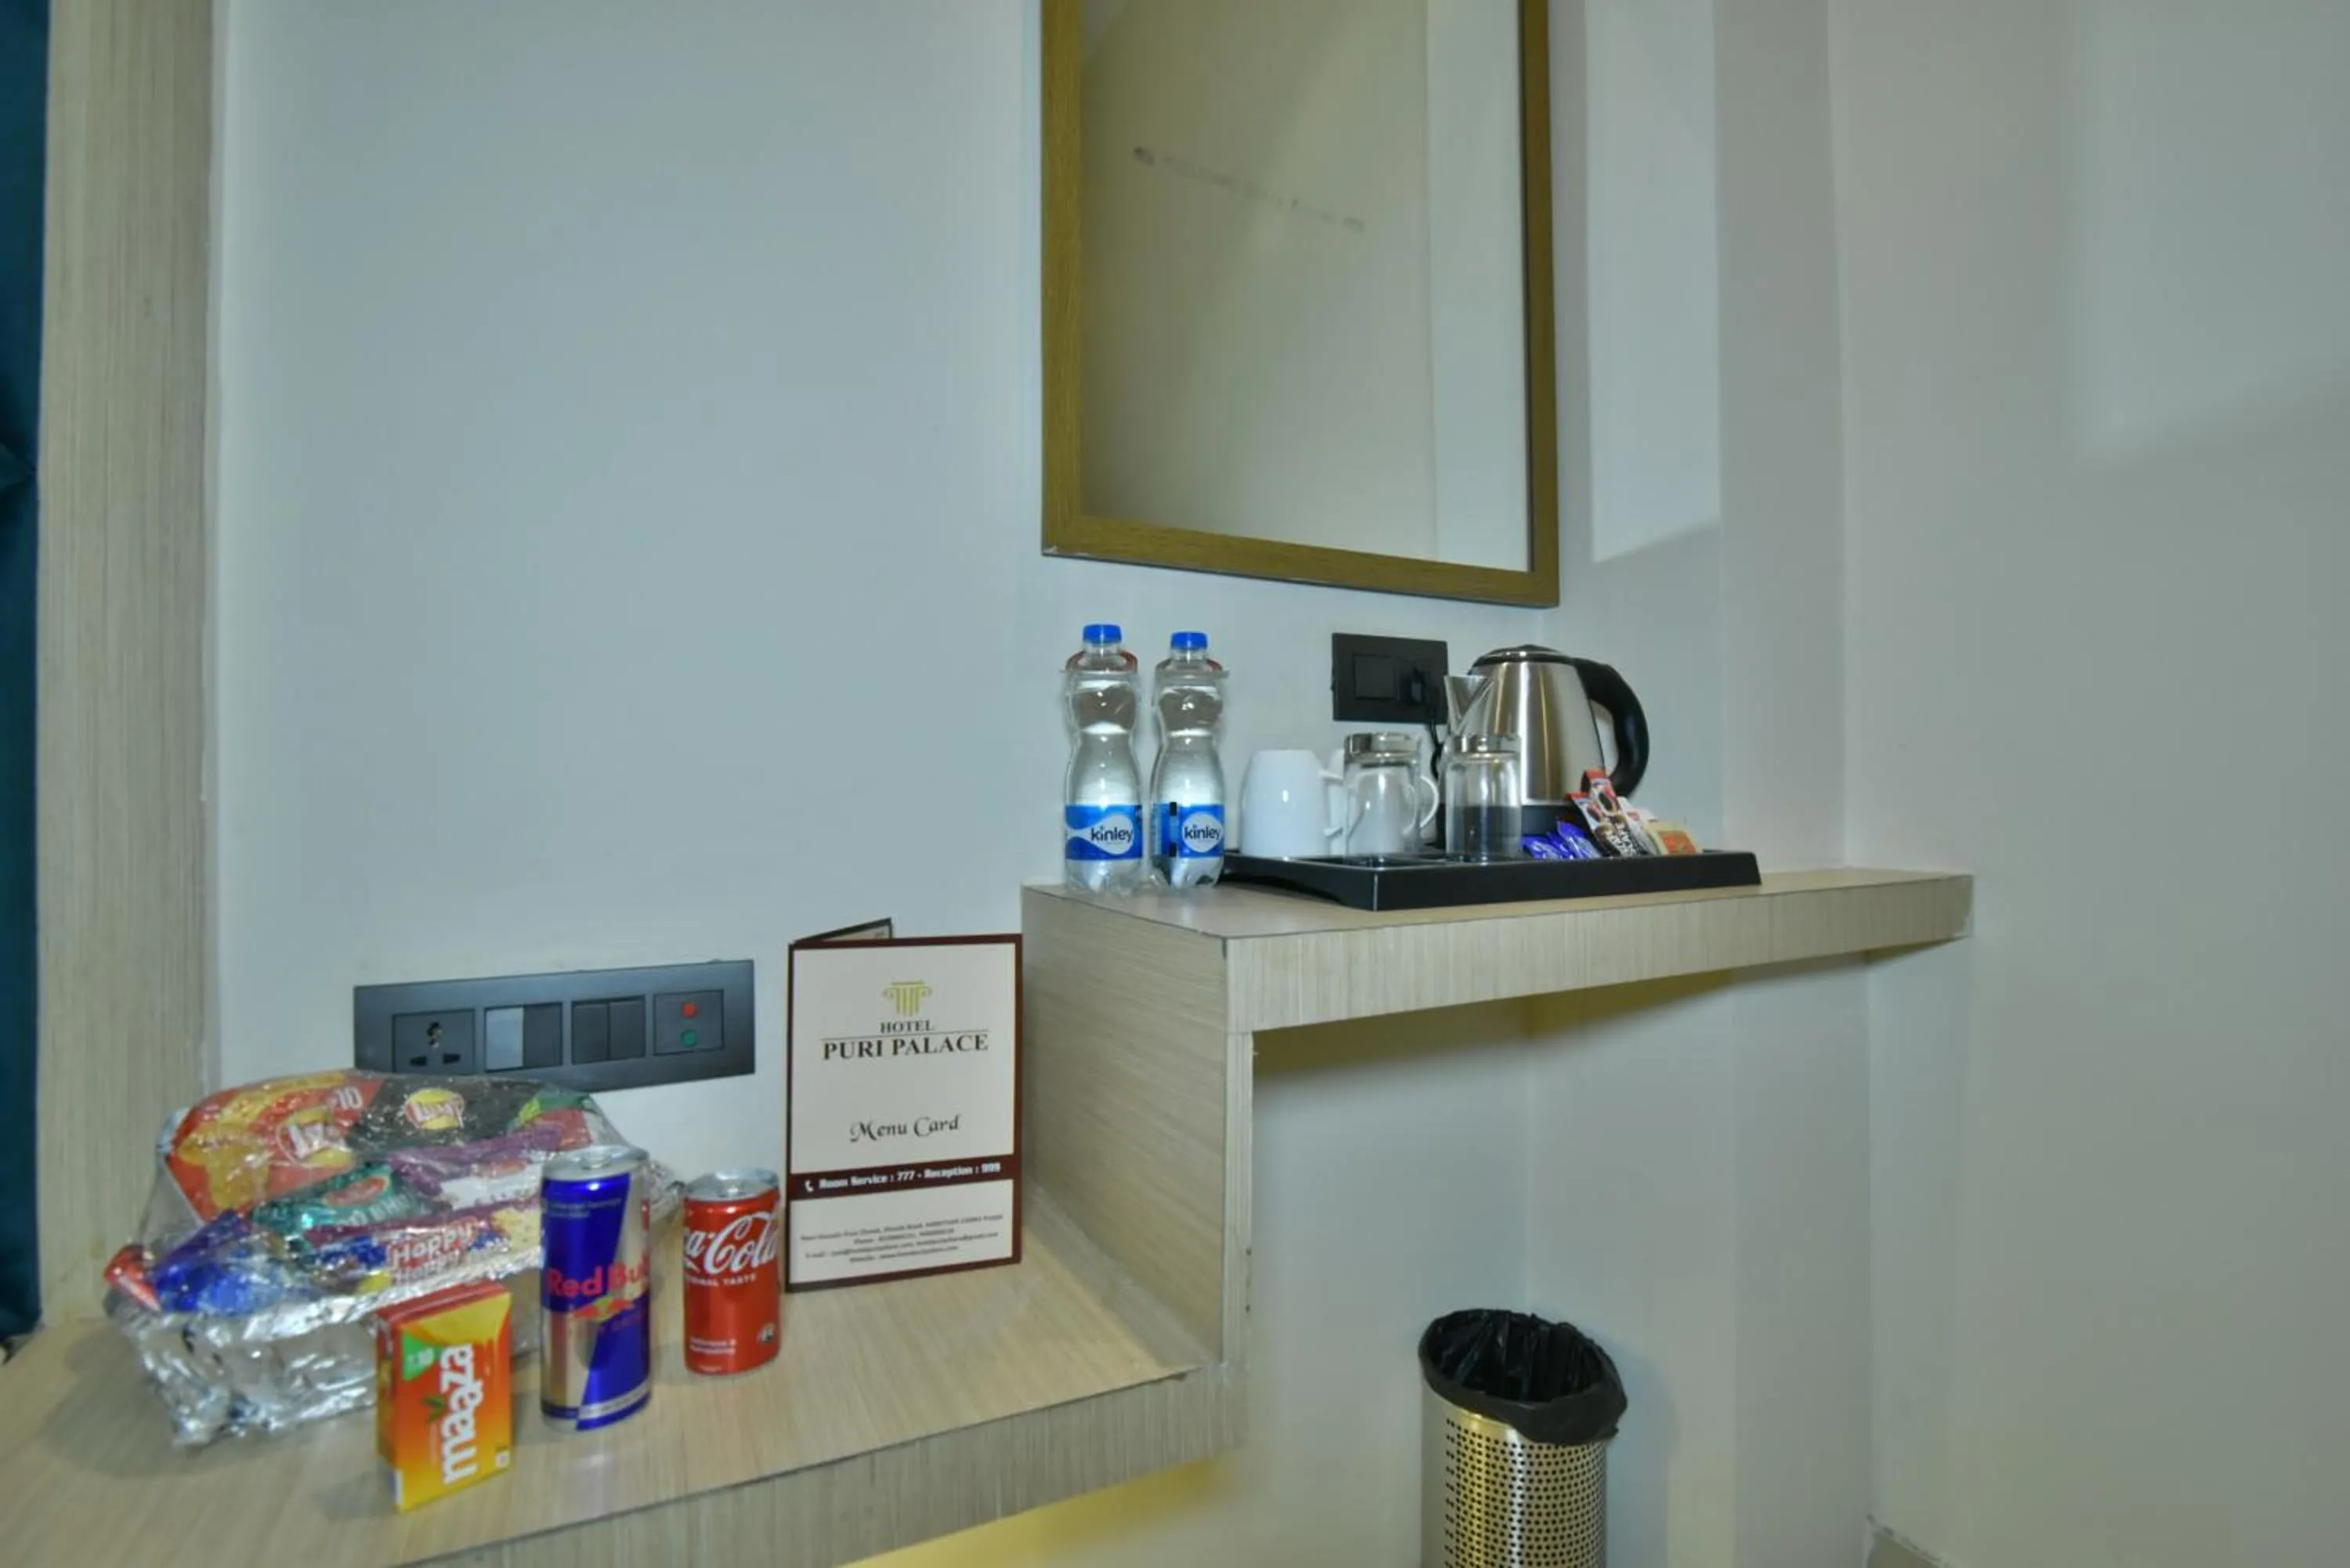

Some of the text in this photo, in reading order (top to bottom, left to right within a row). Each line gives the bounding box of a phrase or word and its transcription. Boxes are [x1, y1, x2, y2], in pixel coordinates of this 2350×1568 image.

[1091, 826, 1133, 843] kinley
[1184, 825, 1221, 840] kinley
[880, 1020, 935, 1034] HOTEL
[823, 1033, 989, 1061] PURI PALACE
[850, 1113, 961, 1143] Menu Card
[851, 1173, 888, 1187] Service
[897, 1171, 916, 1181] 777
[924, 1165, 973, 1179] Reception
[548, 1265, 602, 1298] Red
[439, 1344, 483, 1484] maaza
